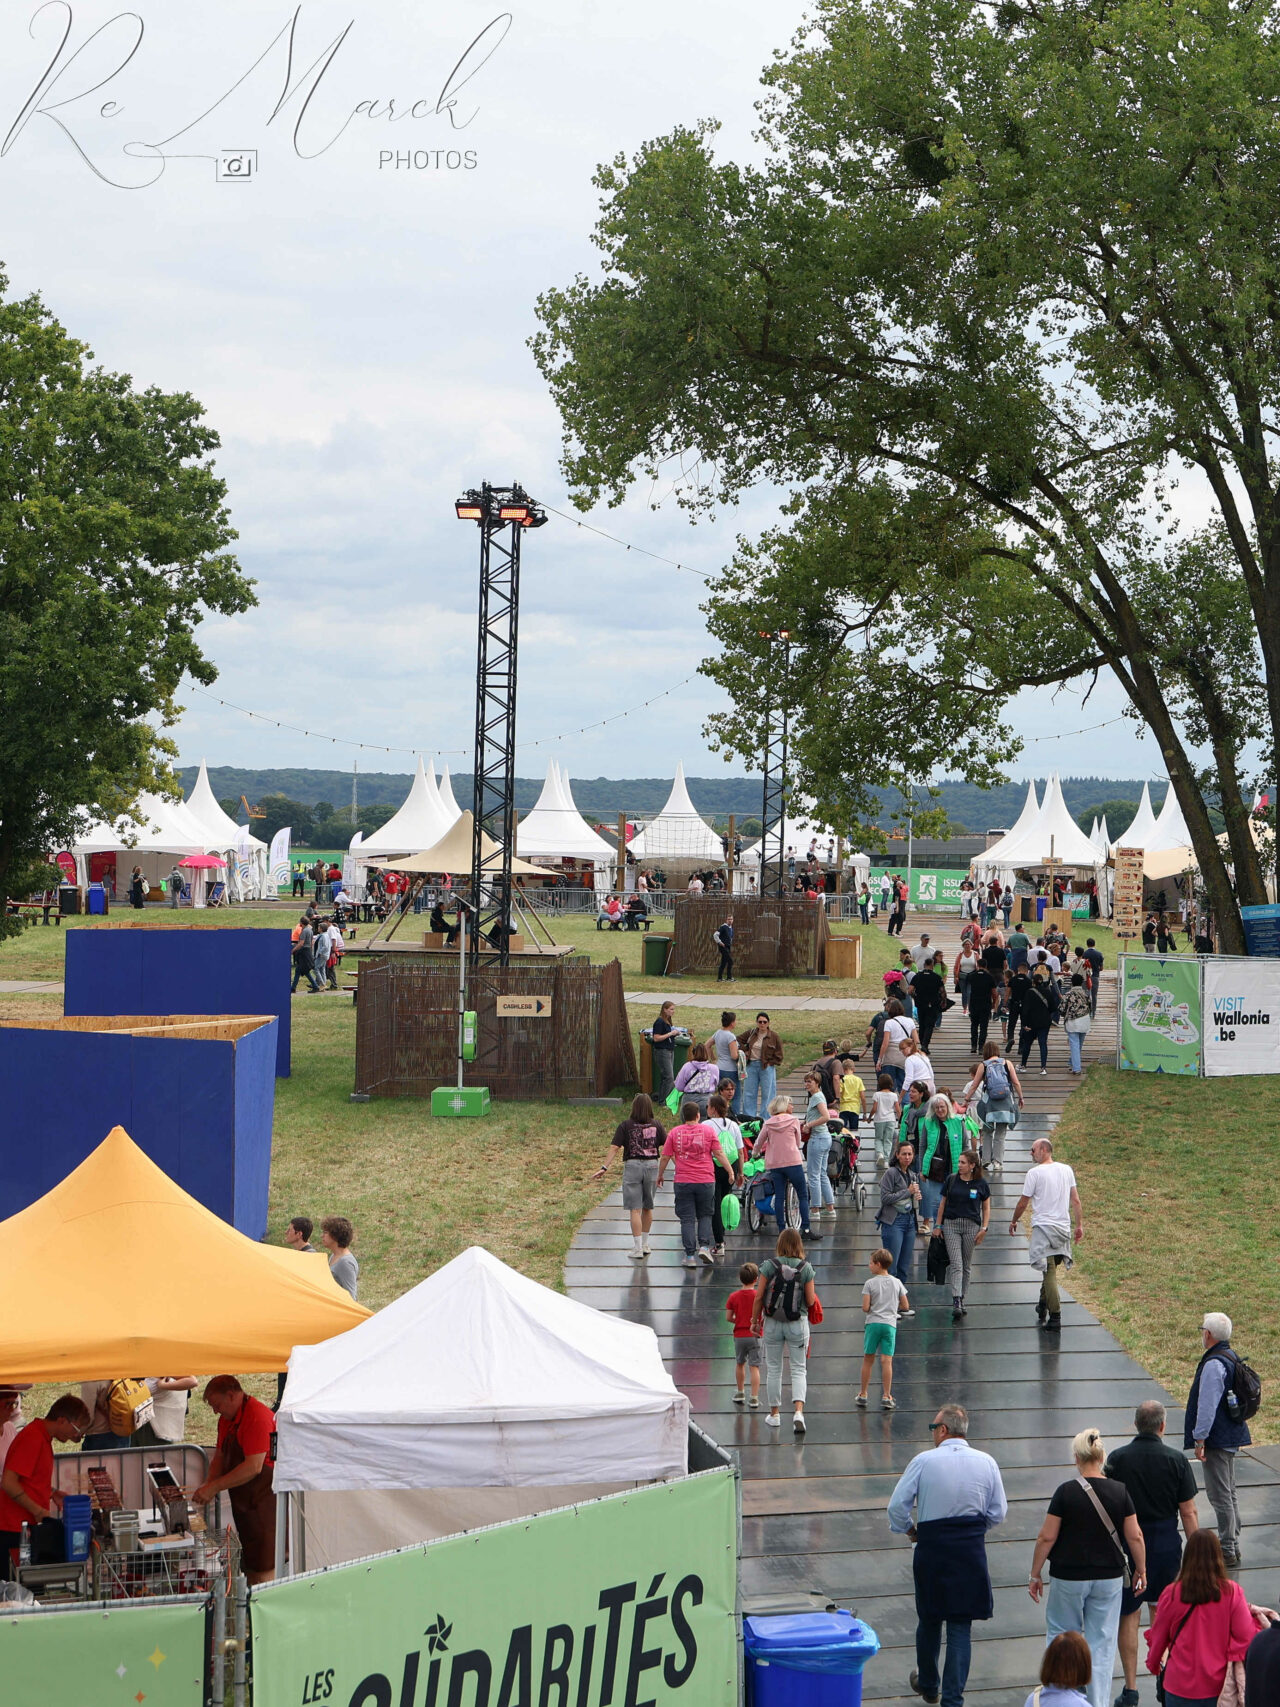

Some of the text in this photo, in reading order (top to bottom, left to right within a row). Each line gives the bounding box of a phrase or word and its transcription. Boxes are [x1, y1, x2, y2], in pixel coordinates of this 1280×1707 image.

[1213, 997, 1246, 1011] VISIT
[1213, 1009, 1270, 1026] Wallonia
[1214, 1027, 1236, 1042] .be
[302, 1668, 335, 1705] LES
